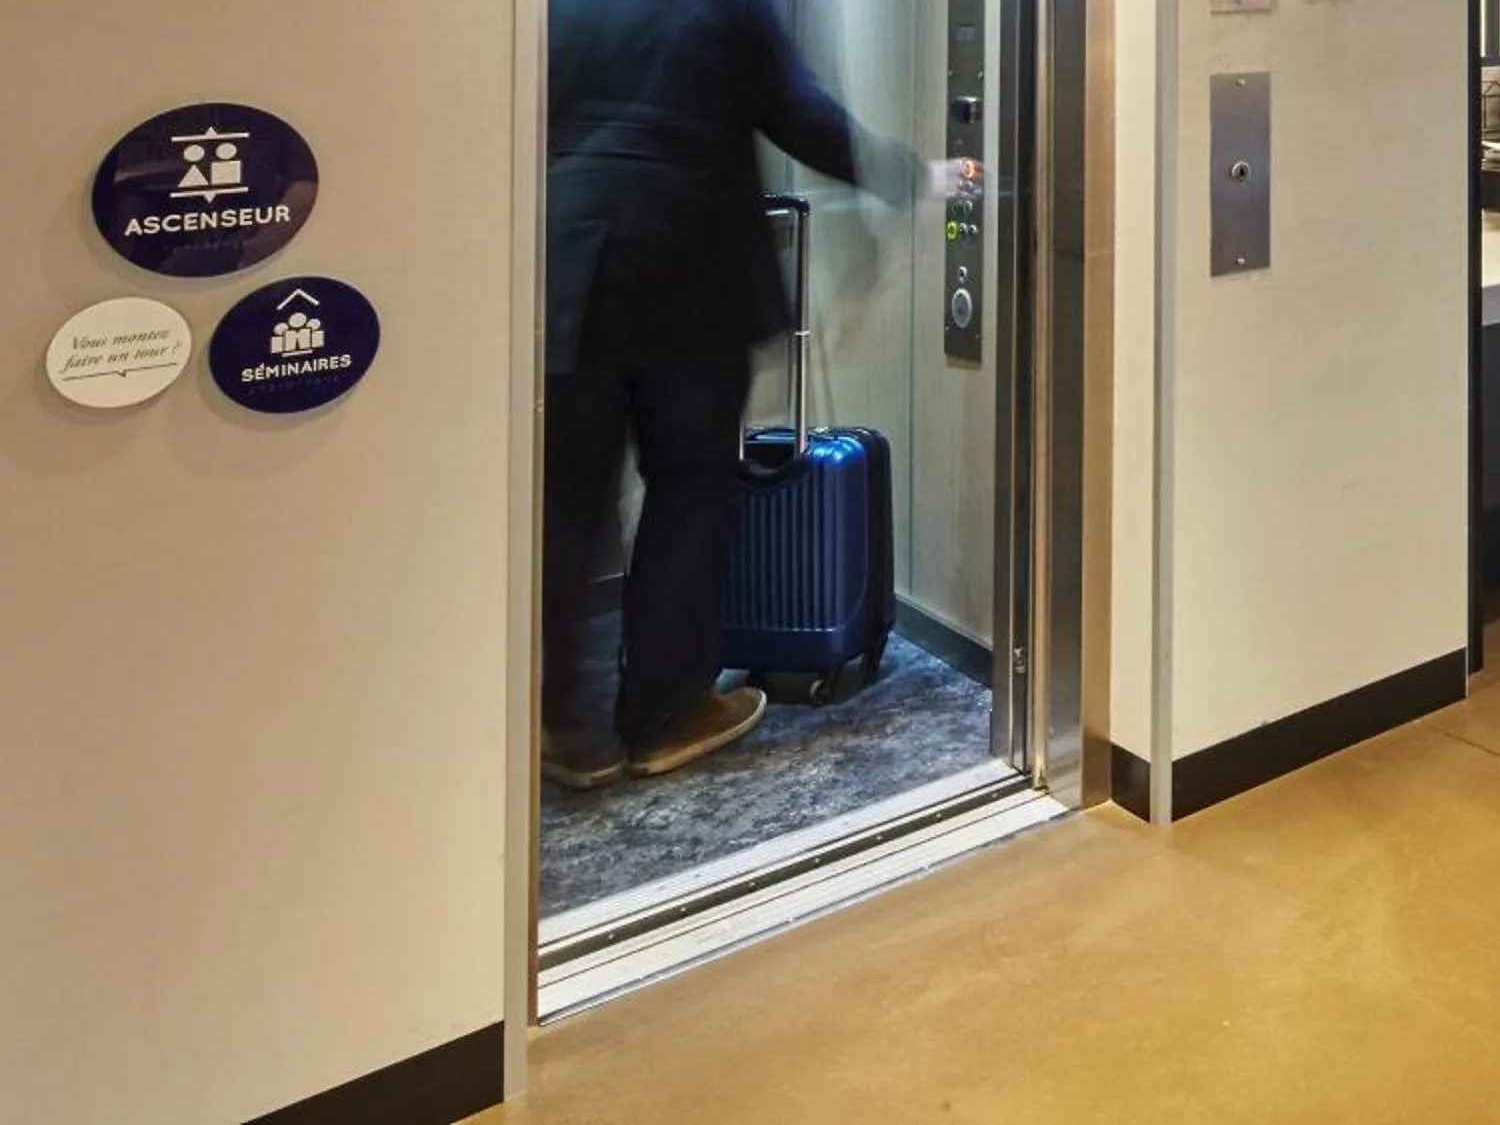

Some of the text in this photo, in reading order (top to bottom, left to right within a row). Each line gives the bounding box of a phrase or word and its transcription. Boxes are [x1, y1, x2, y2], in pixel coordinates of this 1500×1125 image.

[124, 205, 291, 236] ASCENSEUR
[107, 353, 129, 363] un
[241, 354, 352, 382] SÉMINAIRES
